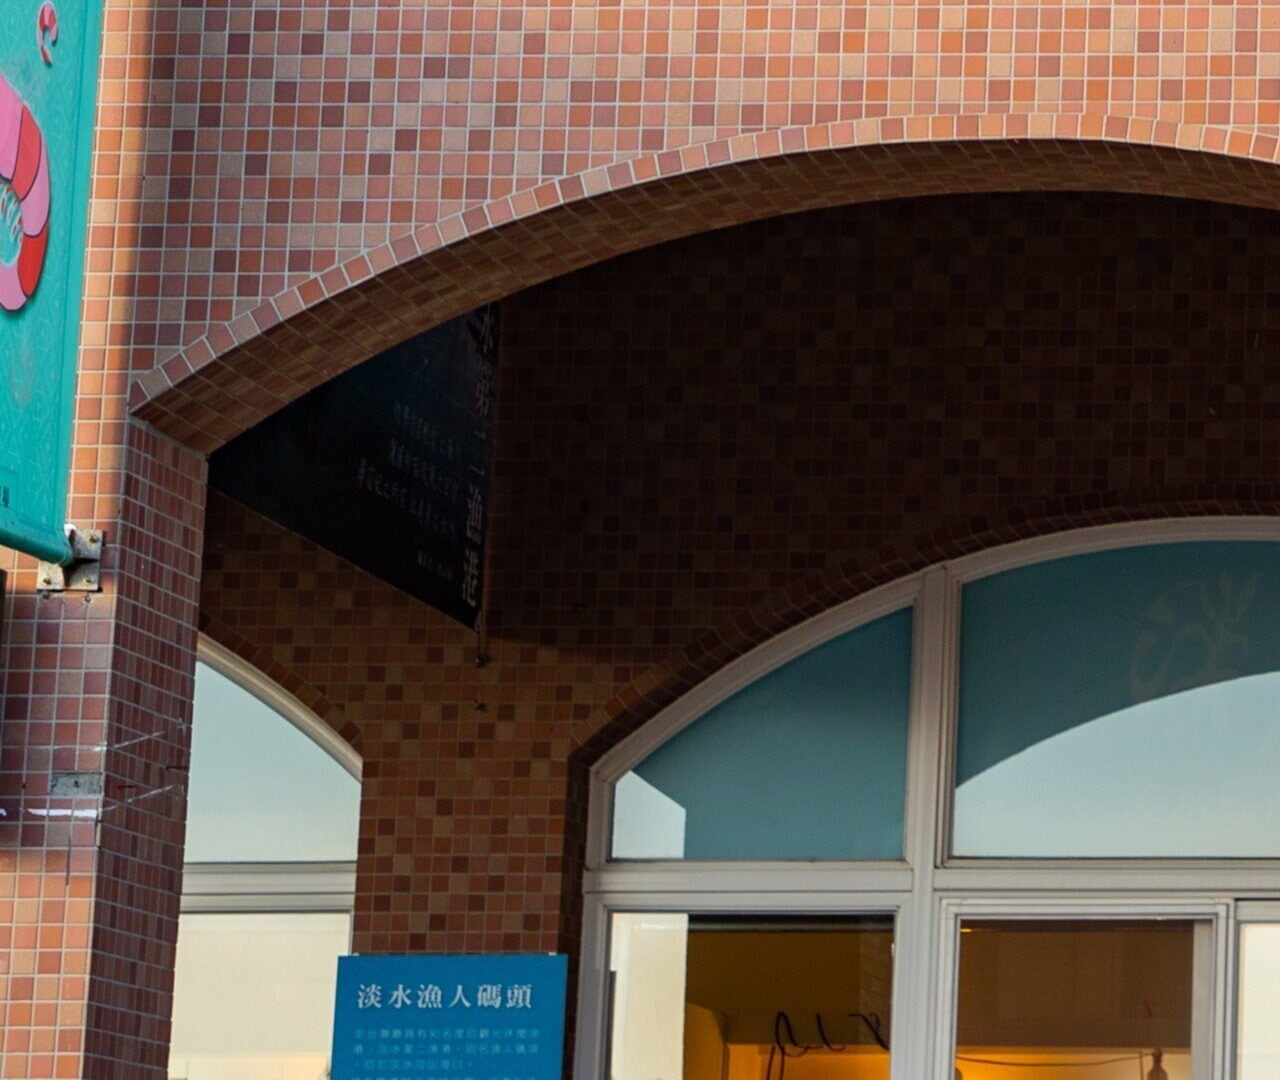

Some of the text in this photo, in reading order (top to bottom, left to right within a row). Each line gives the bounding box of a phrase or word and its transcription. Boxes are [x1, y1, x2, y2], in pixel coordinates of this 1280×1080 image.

[357, 983, 533, 1009] 淡水漁人碼頭
